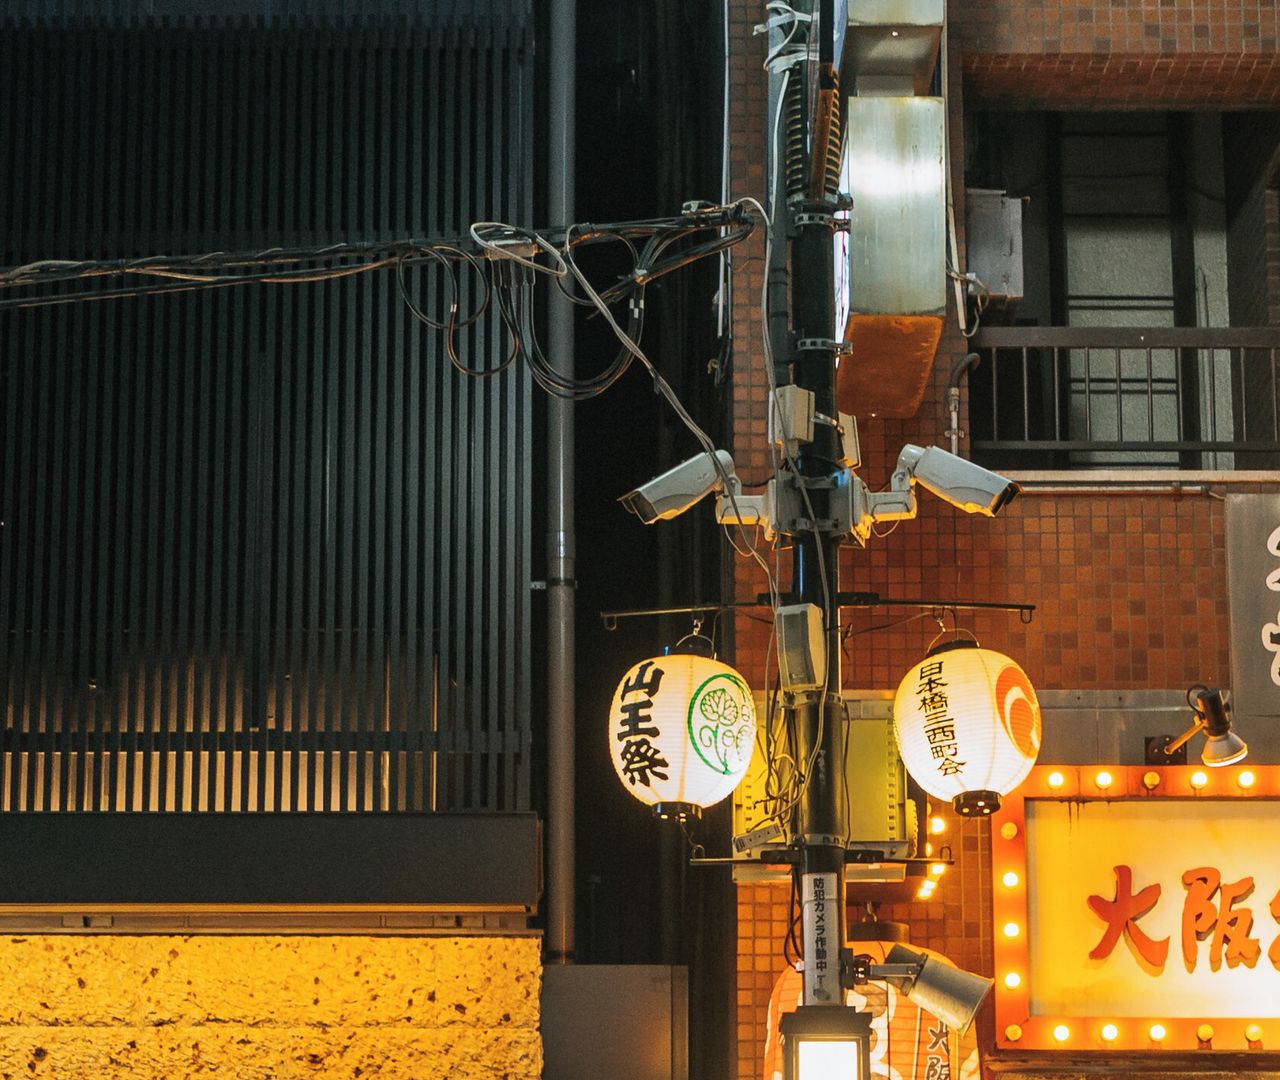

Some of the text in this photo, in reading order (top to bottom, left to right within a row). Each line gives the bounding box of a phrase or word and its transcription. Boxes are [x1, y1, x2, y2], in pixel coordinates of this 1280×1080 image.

[617, 660, 670, 787] 山王祭
[813, 877, 828, 973] 防犯カメラ作動中
